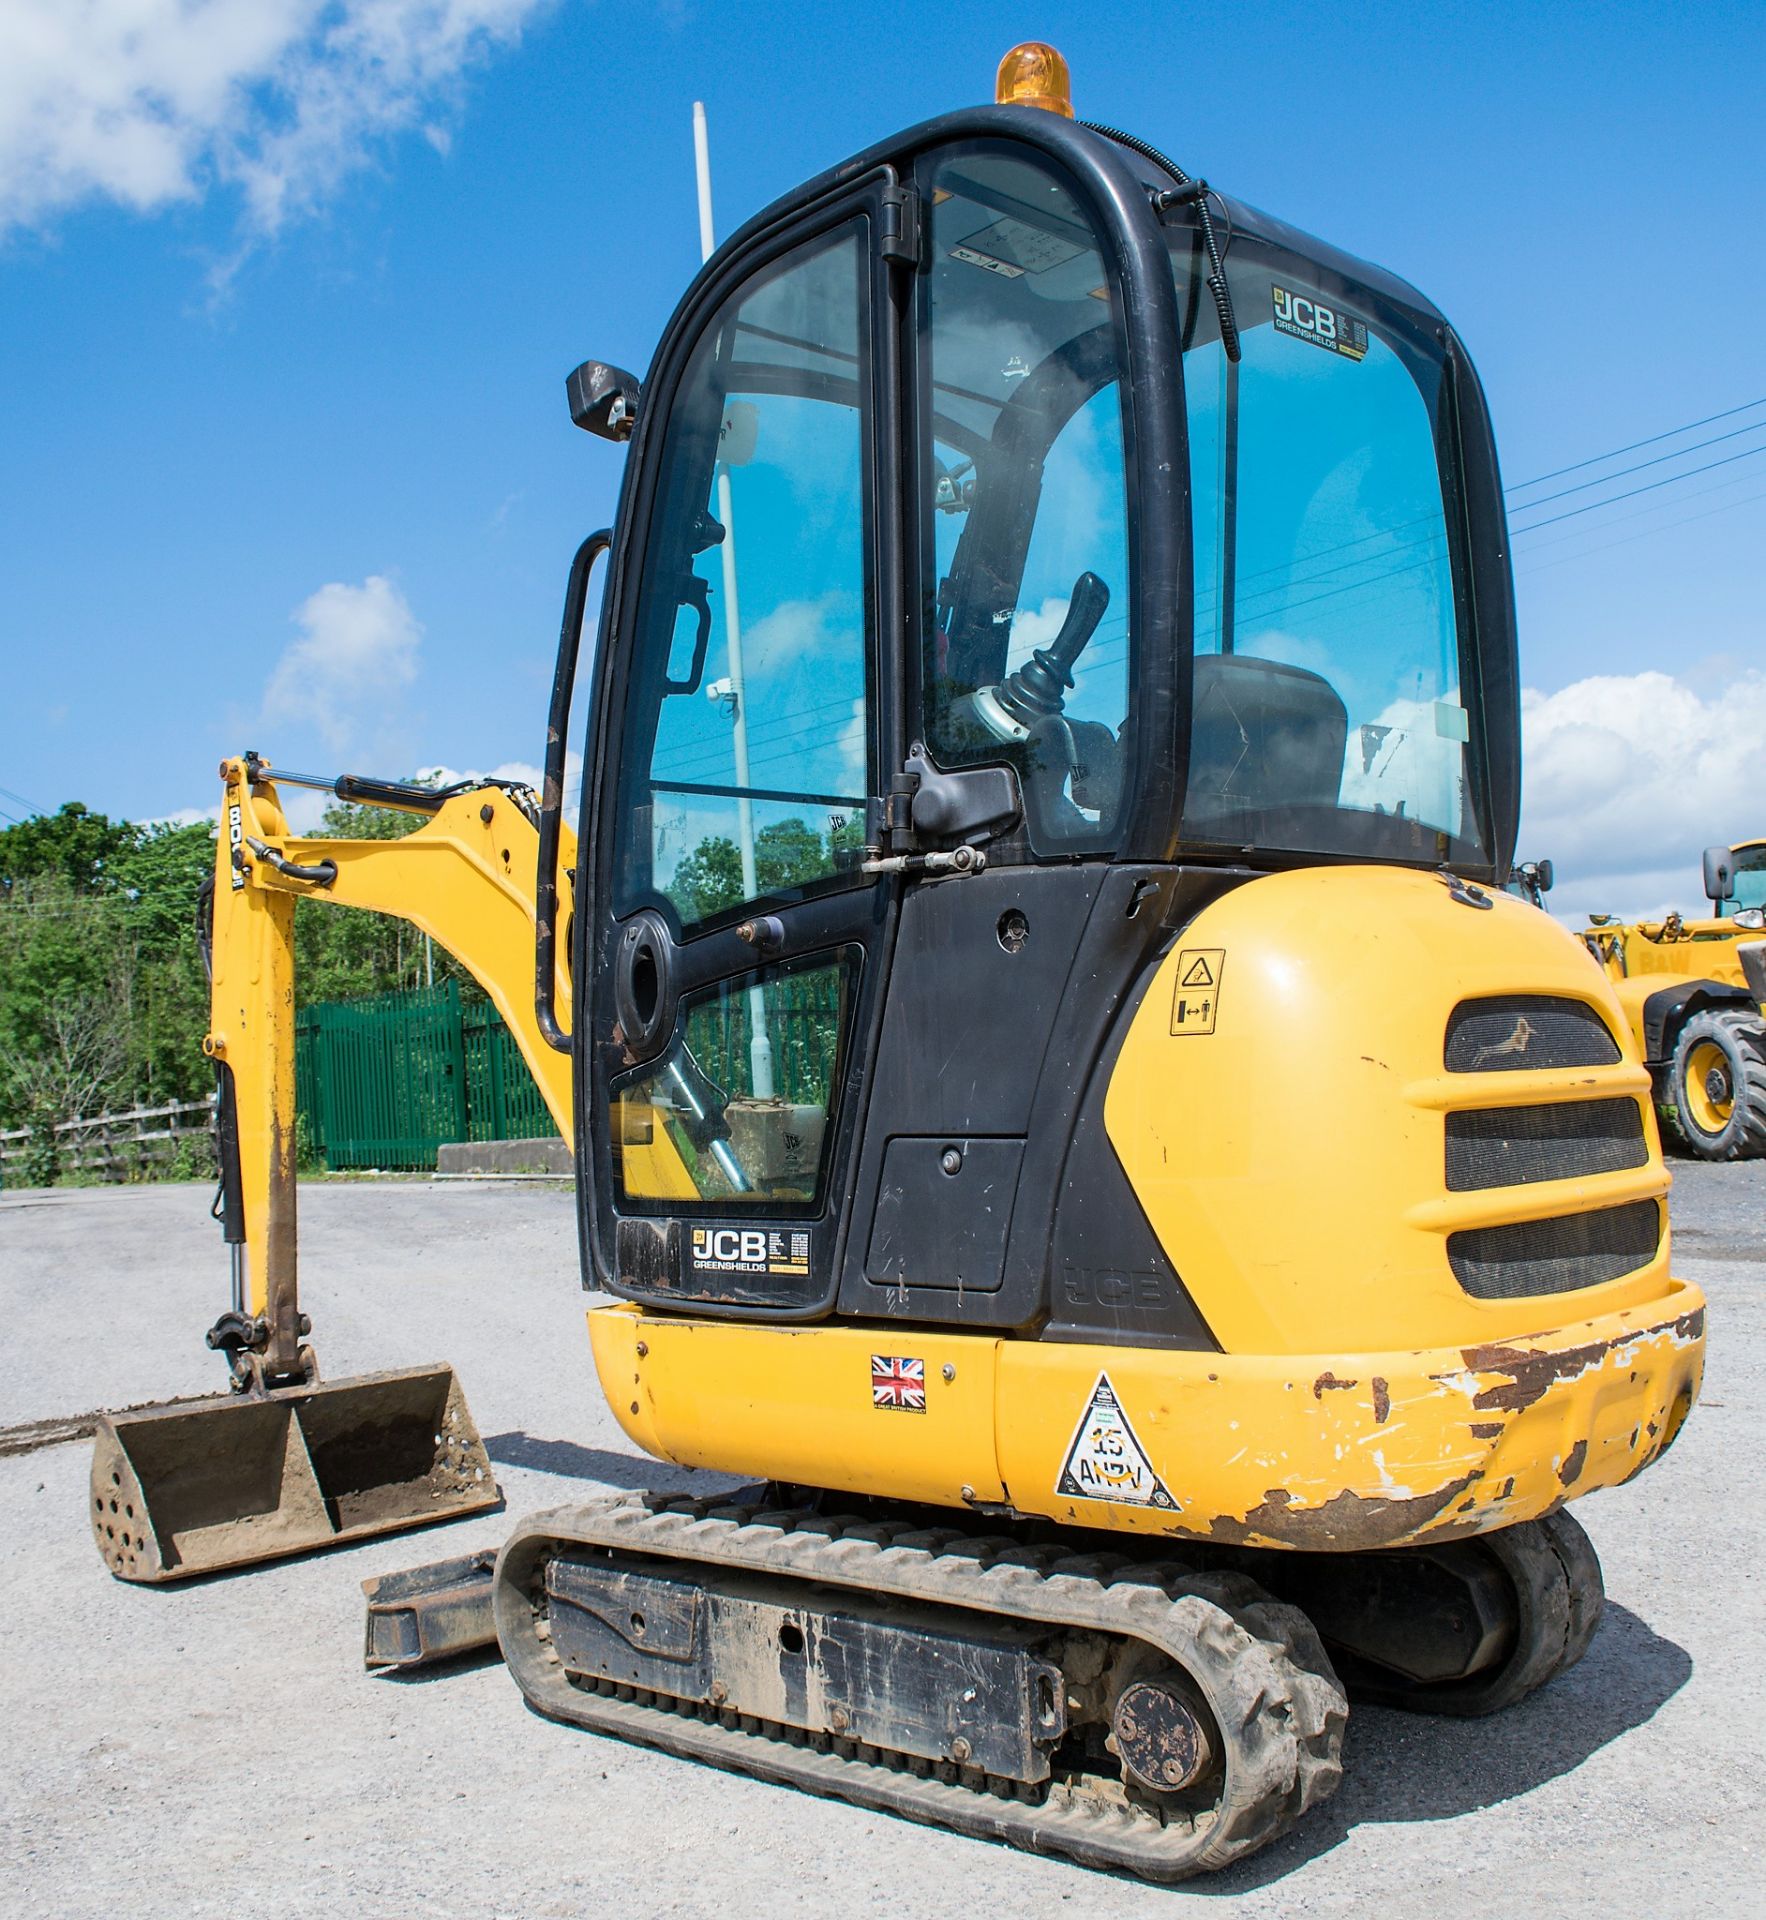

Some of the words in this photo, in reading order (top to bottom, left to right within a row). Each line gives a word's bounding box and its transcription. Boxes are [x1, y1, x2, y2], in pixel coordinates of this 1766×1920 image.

[1274, 292, 1336, 339] JCB
[1276, 319, 1337, 350] GREENSHIELDS
[693, 1230, 767, 1262] JCB
[693, 1260, 767, 1272] GREENSHIELDS
[1064, 1267, 1169, 1309] JCB
